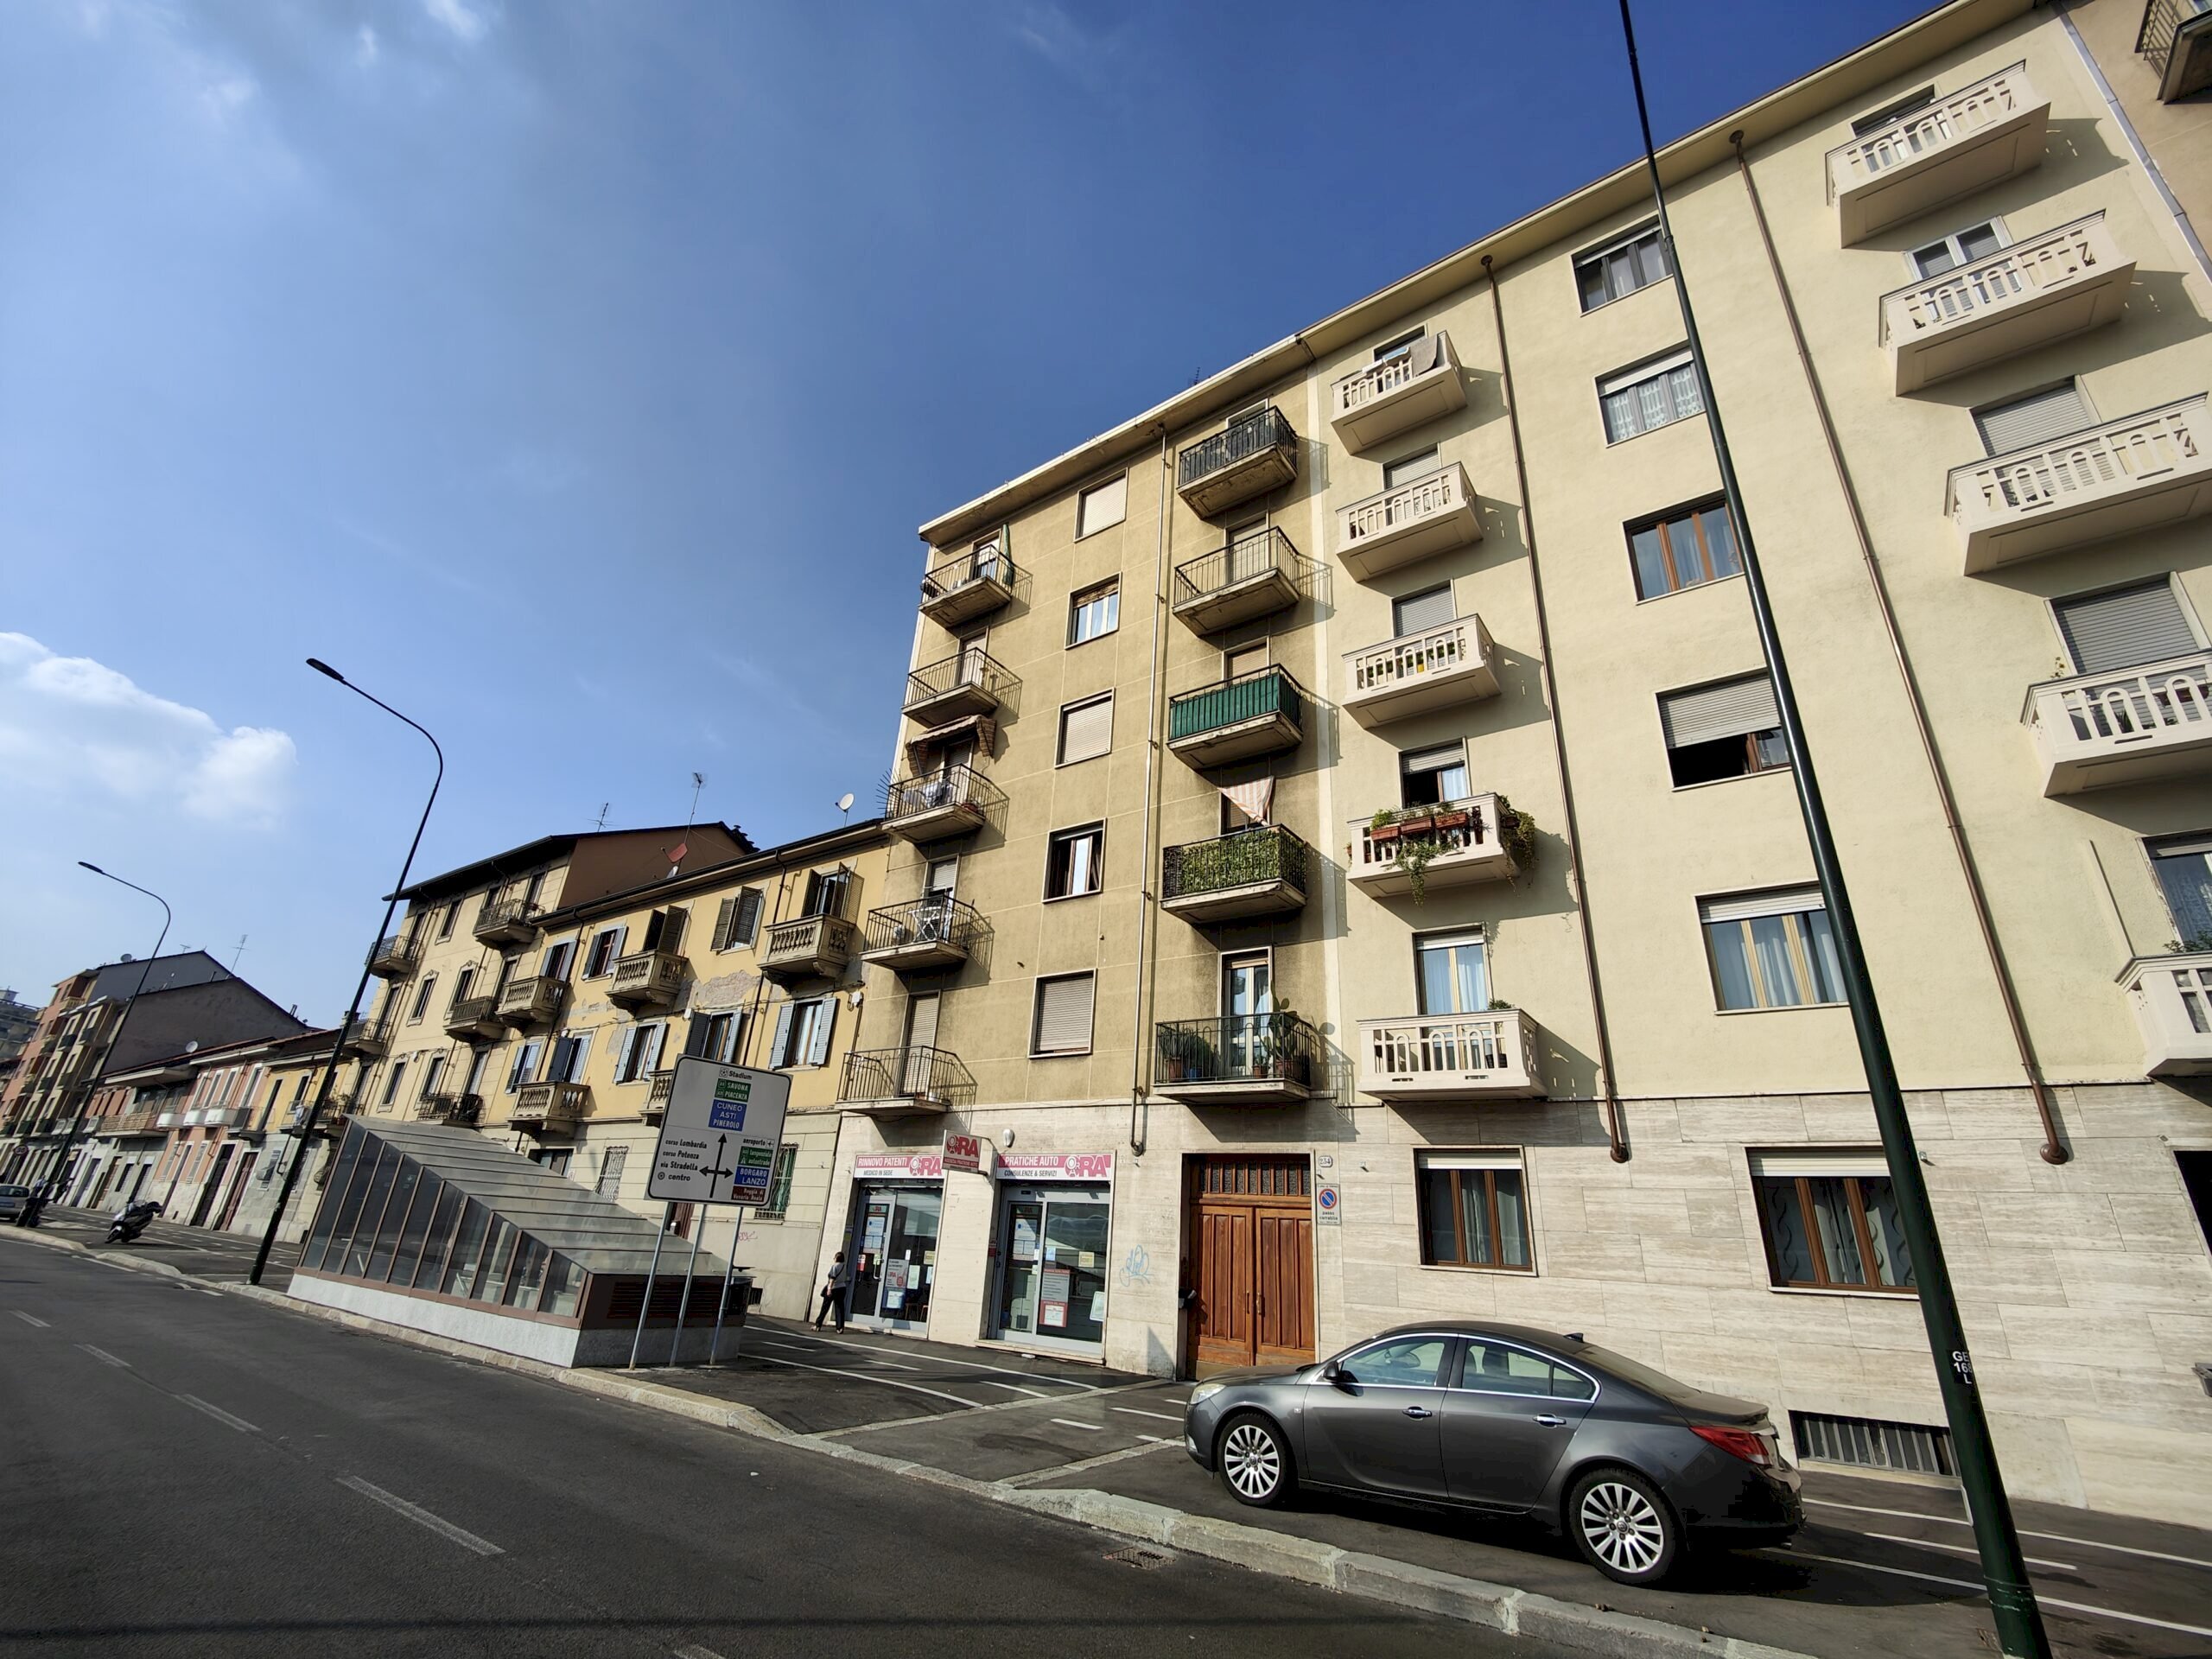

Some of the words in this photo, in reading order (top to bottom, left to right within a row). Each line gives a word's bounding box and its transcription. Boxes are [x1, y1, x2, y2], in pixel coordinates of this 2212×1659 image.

[728, 1071, 753, 1080] Stadium
[728, 1082, 748, 1091] SAVONA
[724, 1091, 747, 1100] PIACENZA
[717, 1102, 743, 1112] CUNEO
[713, 1118, 740, 1128] PINEROLO
[679, 1138, 707, 1148] Lombardia
[677, 1150, 699, 1159] Potenza
[670, 1160, 698, 1171] Stradella
[858, 1158, 884, 1166] RINNOVO
[883, 1157, 907, 1166] PATENTI
[1005, 1156, 1039, 1166] PRATICHE
[1039, 1156, 1058, 1166] AUTO
[740, 1168, 767, 1177] BORGARO
[741, 1176, 766, 1186] LANZO
[1952, 1351, 1970, 1362] GE
[1963, 1373, 1973, 1384] L
